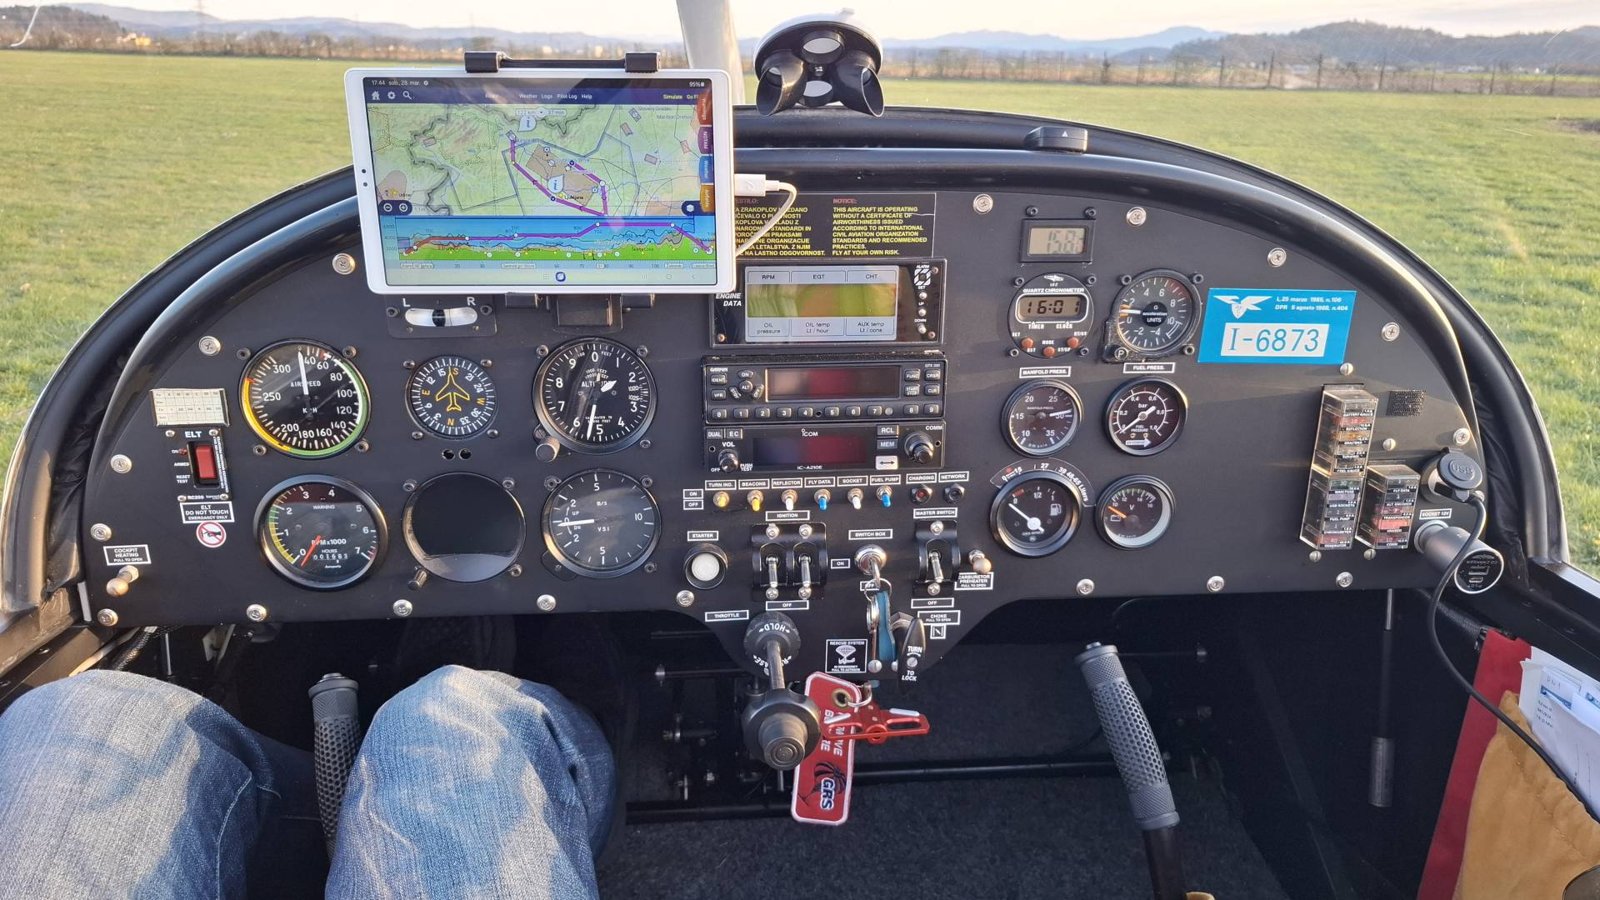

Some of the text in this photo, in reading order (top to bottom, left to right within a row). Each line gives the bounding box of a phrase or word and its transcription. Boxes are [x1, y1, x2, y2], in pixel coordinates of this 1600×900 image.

[1159, 288, 1165, 297] 6
[402, 298, 410, 307] L
[466, 297, 476, 306] R
[1027, 300, 1080, 314] 16:01
[1167, 317, 1175, 325] 10
[1228, 328, 1319, 352] I-6873
[304, 357, 316, 365] 40
[316, 361, 329, 370] 60
[569, 358, 576, 369] 9
[272, 364, 291, 374] 300
[437, 368, 447, 377] 15
[330, 372, 343, 381] 80
[426, 376, 436, 385] 12
[628, 372, 636, 382] 2
[555, 377, 564, 388] 8
[473, 383, 484, 393] 24
[262, 392, 281, 402] 250
[337, 389, 353, 398] 100
[337, 406, 352, 414] 120
[630, 402, 638, 412] 3
[330, 421, 346, 429] 140
[573, 417, 581, 427] 6
[281, 423, 299, 432] 200
[596, 424, 604, 435] 5
[298, 430, 315, 439] 180
[316, 428, 332, 437] 160
[1452, 462, 1473, 474] USB
[594, 483, 600, 491] 5
[328, 489, 335, 497] 4
[1078, 484, 1088, 502] Liters
[570, 499, 577, 507] 2
[634, 513, 643, 521] 10
[573, 534, 579, 542] 2
[600, 547, 606, 555] 5
[764, 623, 786, 632] HOLD
[821, 778, 834, 809] GRS
